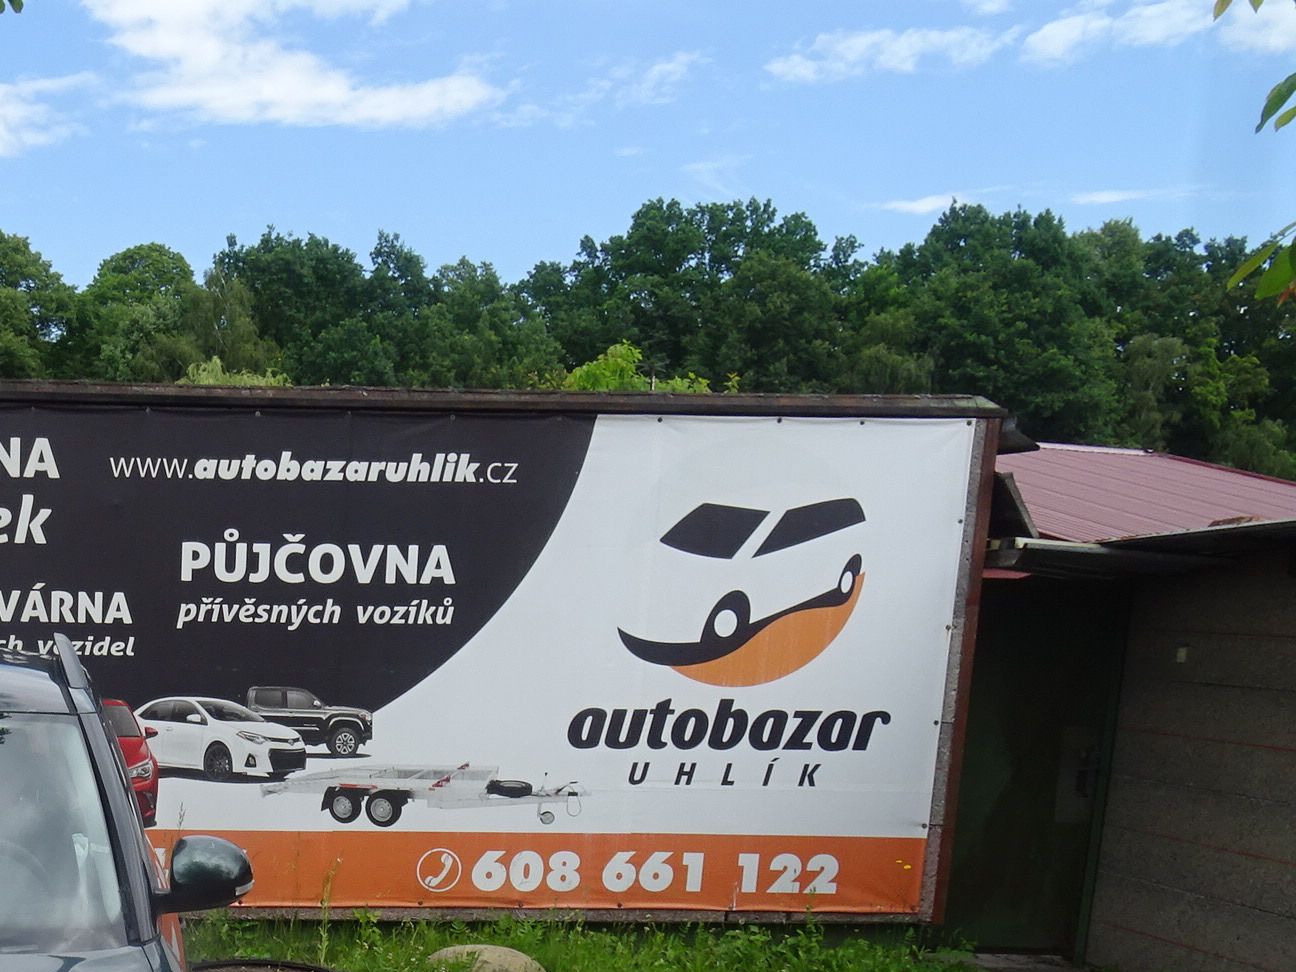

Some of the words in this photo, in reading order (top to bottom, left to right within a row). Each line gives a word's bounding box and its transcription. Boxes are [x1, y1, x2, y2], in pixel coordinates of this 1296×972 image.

[109, 451, 519, 484] www.autobazaruhlik.cz
[180, 528, 456, 585] PŮJČOVNA
[176, 596, 341, 630] přívěsných
[356, 597, 455, 625] vozíků
[567, 698, 891, 752] autobazar
[628, 757, 822, 787] UHLÍK
[471, 850, 581, 892] 608
[602, 851, 704, 893] 661
[737, 853, 840, 894] 122
